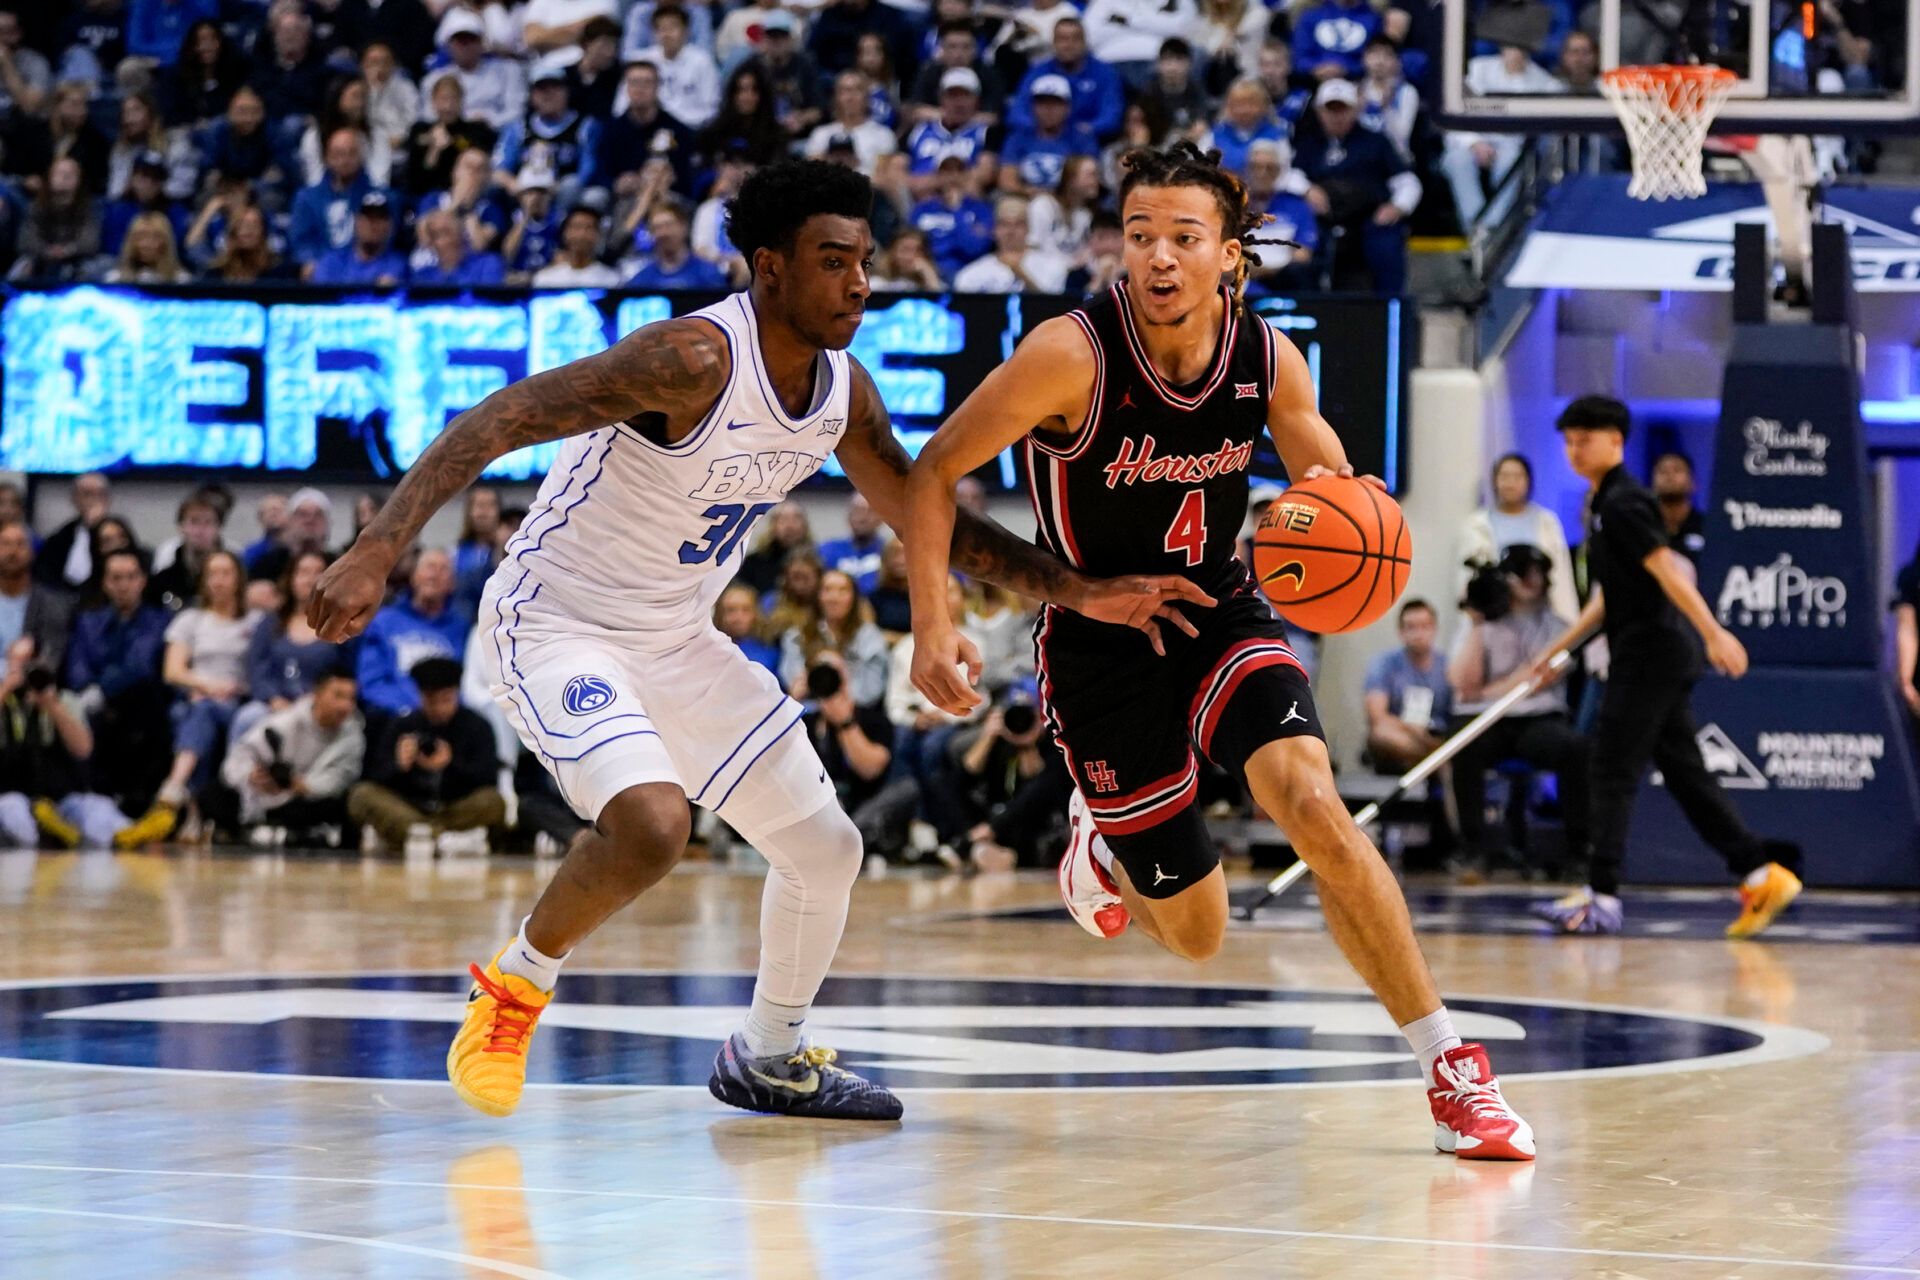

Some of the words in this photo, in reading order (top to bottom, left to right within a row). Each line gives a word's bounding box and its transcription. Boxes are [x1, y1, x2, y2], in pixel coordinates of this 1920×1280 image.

[1164, 488, 1207, 567] 4
[1757, 731, 1885, 759] MOUNTAIN
[1765, 753, 1876, 781] AMERICA
